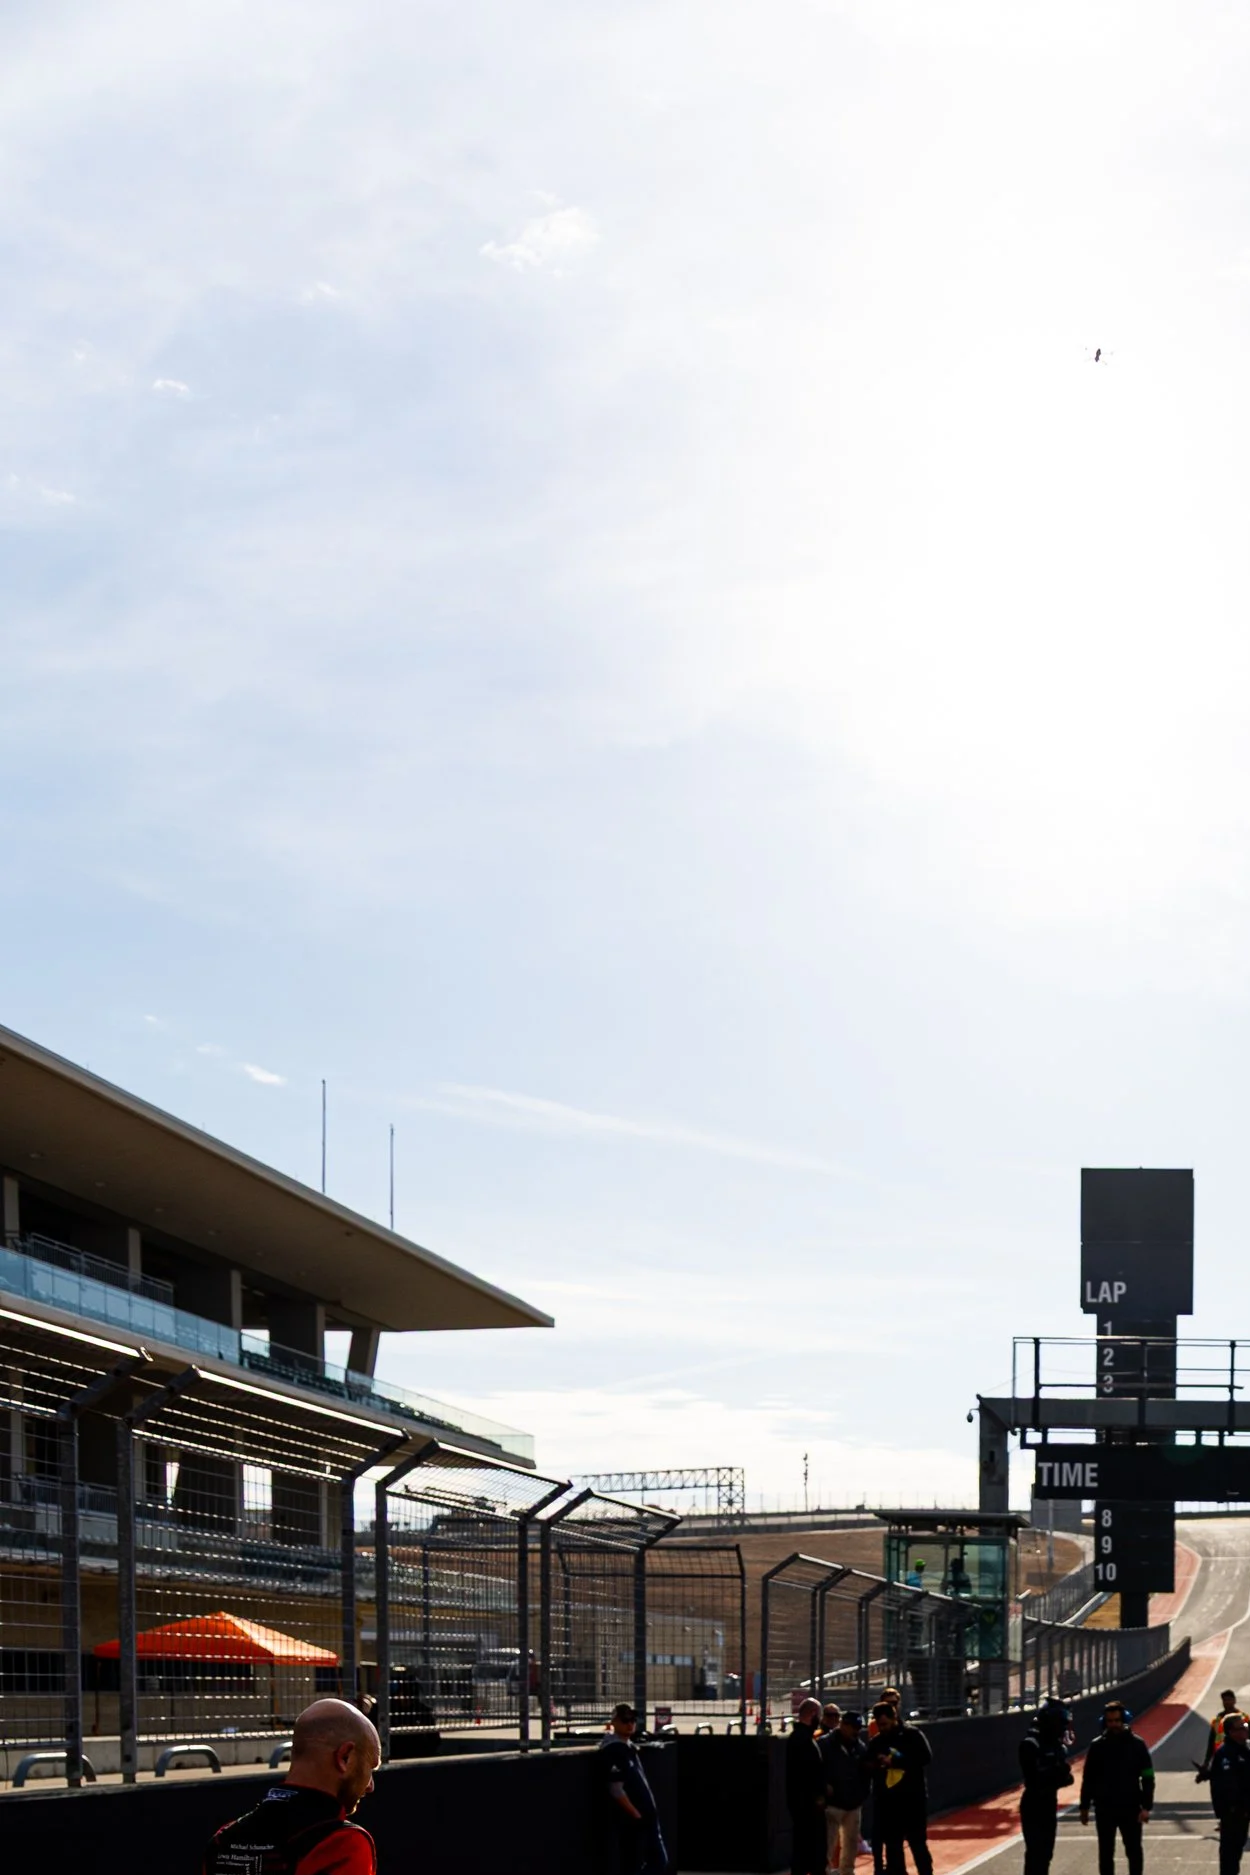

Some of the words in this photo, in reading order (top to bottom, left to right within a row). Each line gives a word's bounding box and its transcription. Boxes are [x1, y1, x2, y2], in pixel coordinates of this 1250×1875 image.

[1085, 1281, 1127, 1304] LAP
[1103, 1320, 1113, 1337] 1
[1102, 1347, 1115, 1367] 2
[1102, 1374, 1114, 1394] 3
[1038, 1462, 1099, 1488] TIME
[1101, 1508, 1113, 1528] 8
[1101, 1535, 1113, 1555] 9
[1095, 1562, 1118, 1582] 10
